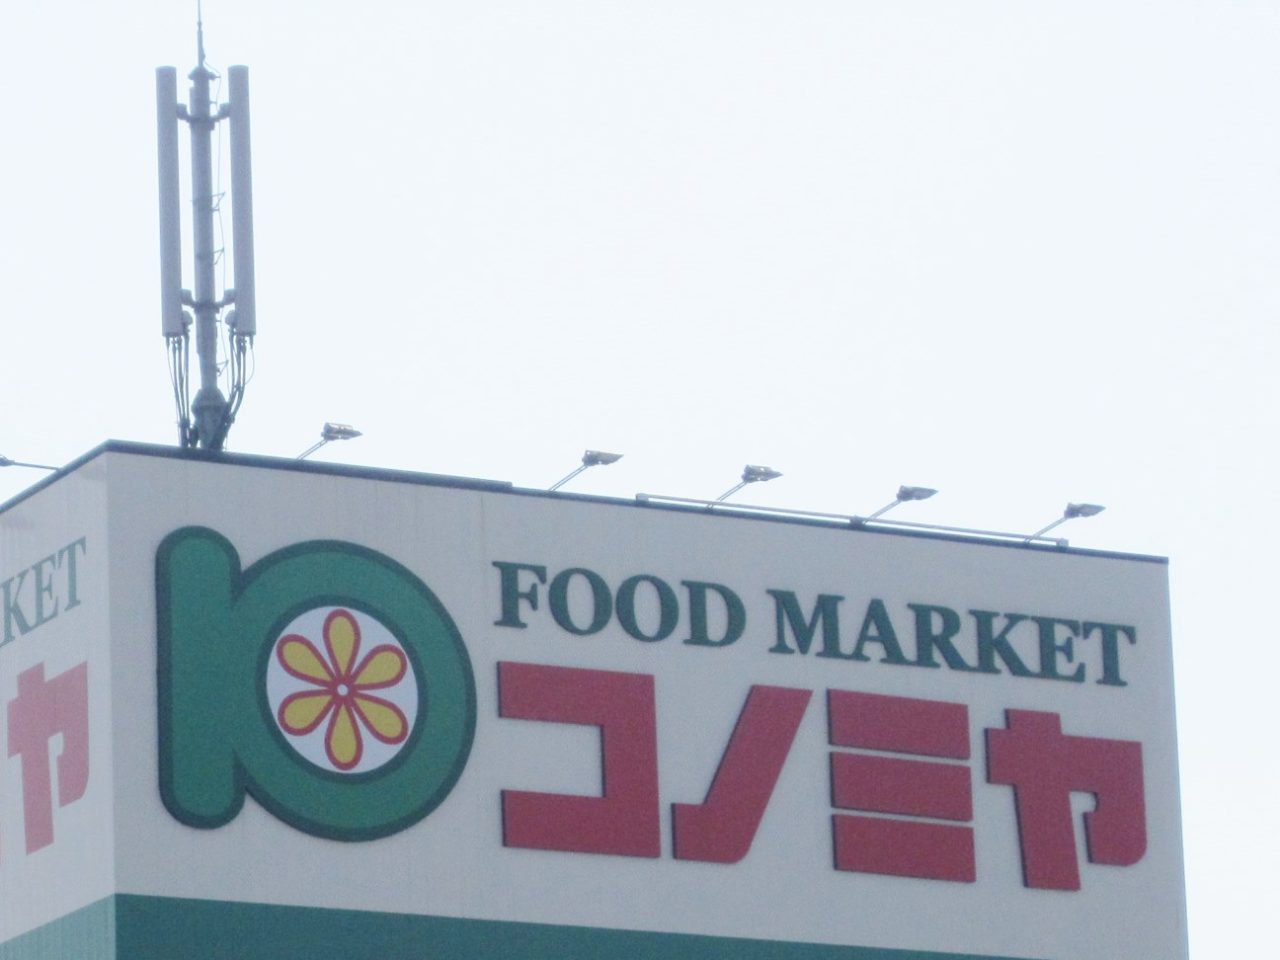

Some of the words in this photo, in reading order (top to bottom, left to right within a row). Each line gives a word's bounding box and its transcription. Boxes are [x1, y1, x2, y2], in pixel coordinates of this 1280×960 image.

[492, 560, 746, 648] FOOD
[767, 589, 1137, 687] MARKET
[496, 659, 1148, 892] コノミヤ
